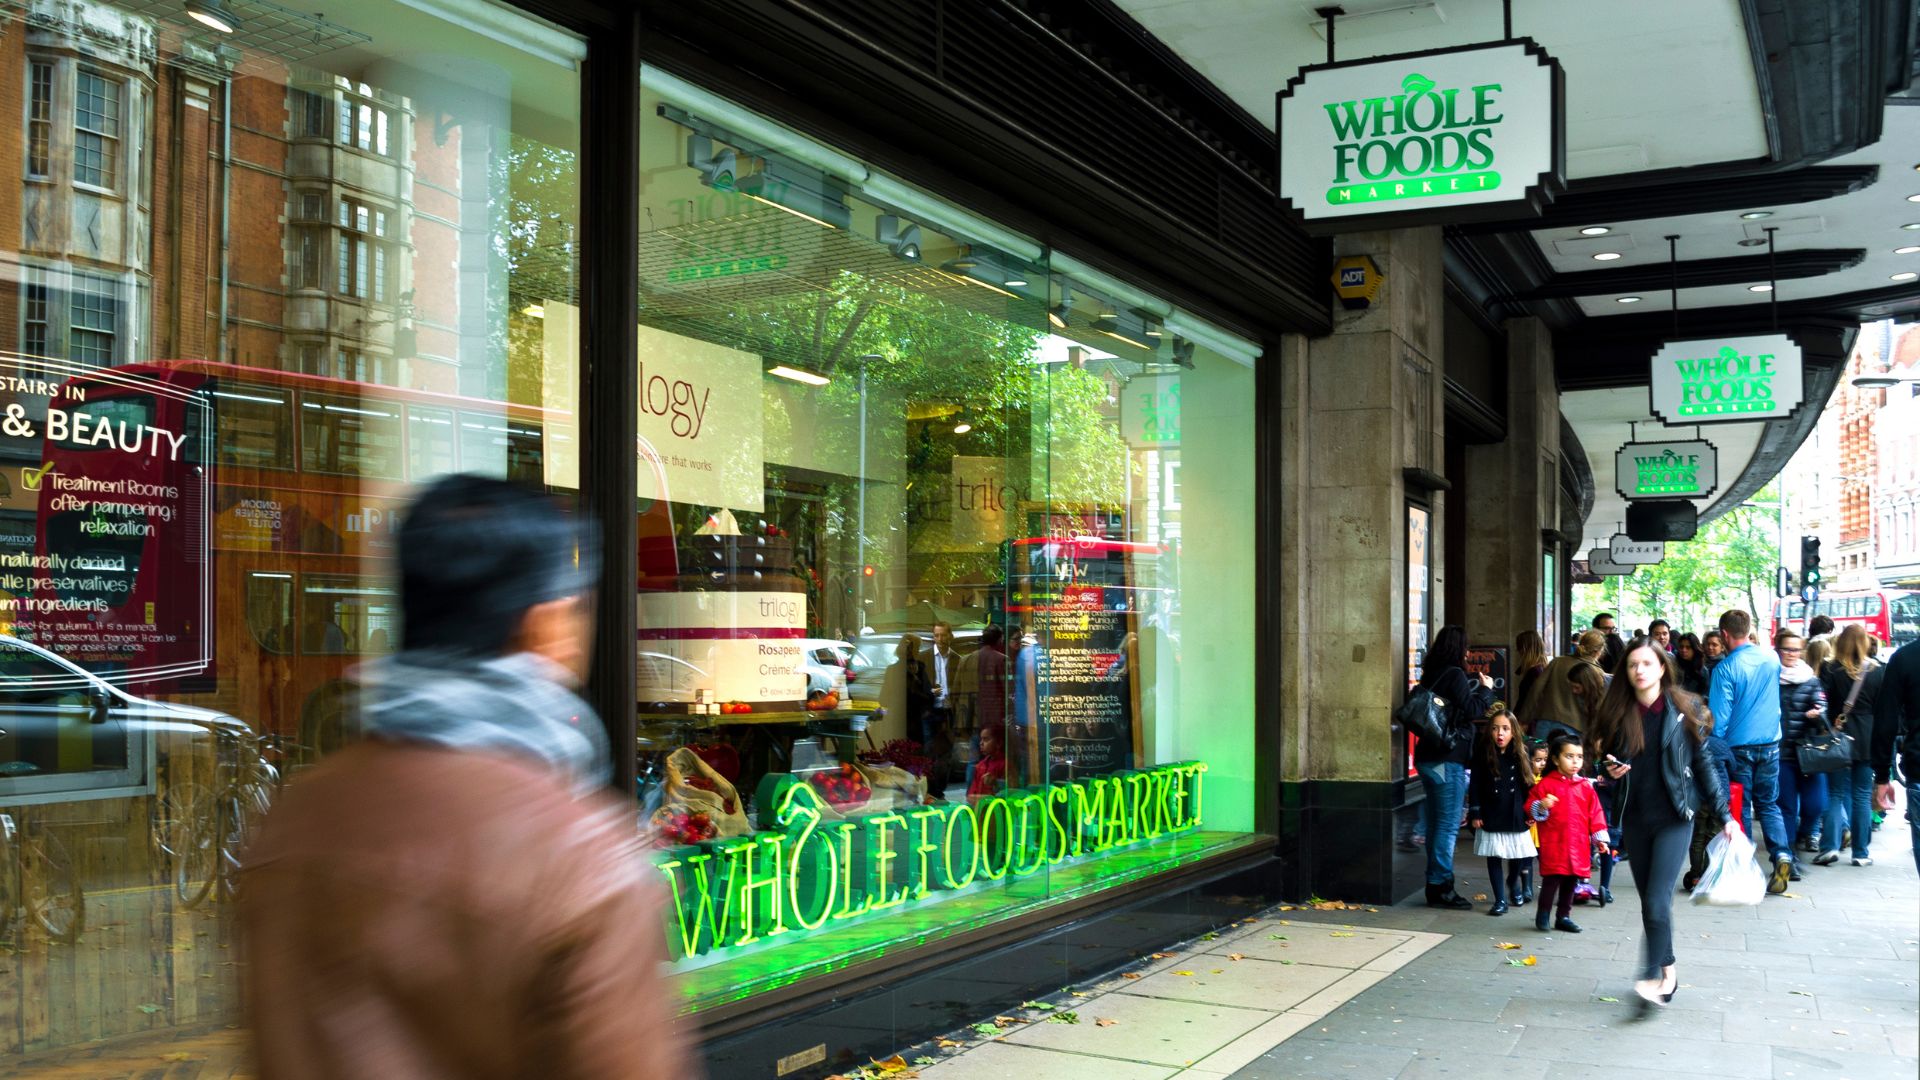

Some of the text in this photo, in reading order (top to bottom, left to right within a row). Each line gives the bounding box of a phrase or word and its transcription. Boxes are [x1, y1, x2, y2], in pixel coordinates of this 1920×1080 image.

[1323, 78, 1504, 142] WHOLE
[1332, 127, 1495, 184] FOODS
[1339, 175, 1487, 201] MARKET
[1341, 269, 1365, 283] ADT
[1675, 350, 1776, 382] WHOLE
[65, 385, 86, 401] IN
[1681, 377, 1773, 405] FOODS
[1685, 401, 1768, 414] MARKET
[2, 403, 187, 461] & BEAUTY
[671, 454, 687, 468] that
[689, 459, 712, 471] works
[1634, 452, 1699, 470] WHOLE
[46, 472, 179, 499] Treatment Rooms
[1638, 469, 1697, 486] FOODS
[51, 493, 89, 511] offer
[92, 500, 171, 522] pampering
[80, 517, 155, 537] relaxation
[1050, 525, 1101, 549] trilogy
[1614, 546, 1660, 555] JIGSAW
[1, 550, 125, 573] naturally derived
[1054, 563, 1089, 577] NEW
[27, 574, 128, 592] preservatives
[25, 595, 110, 615] ingredients
[759, 597, 800, 624] trilogy
[759, 664, 790, 676] Crème
[658, 760, 1209, 960] WHOLE FOODS MARKET
